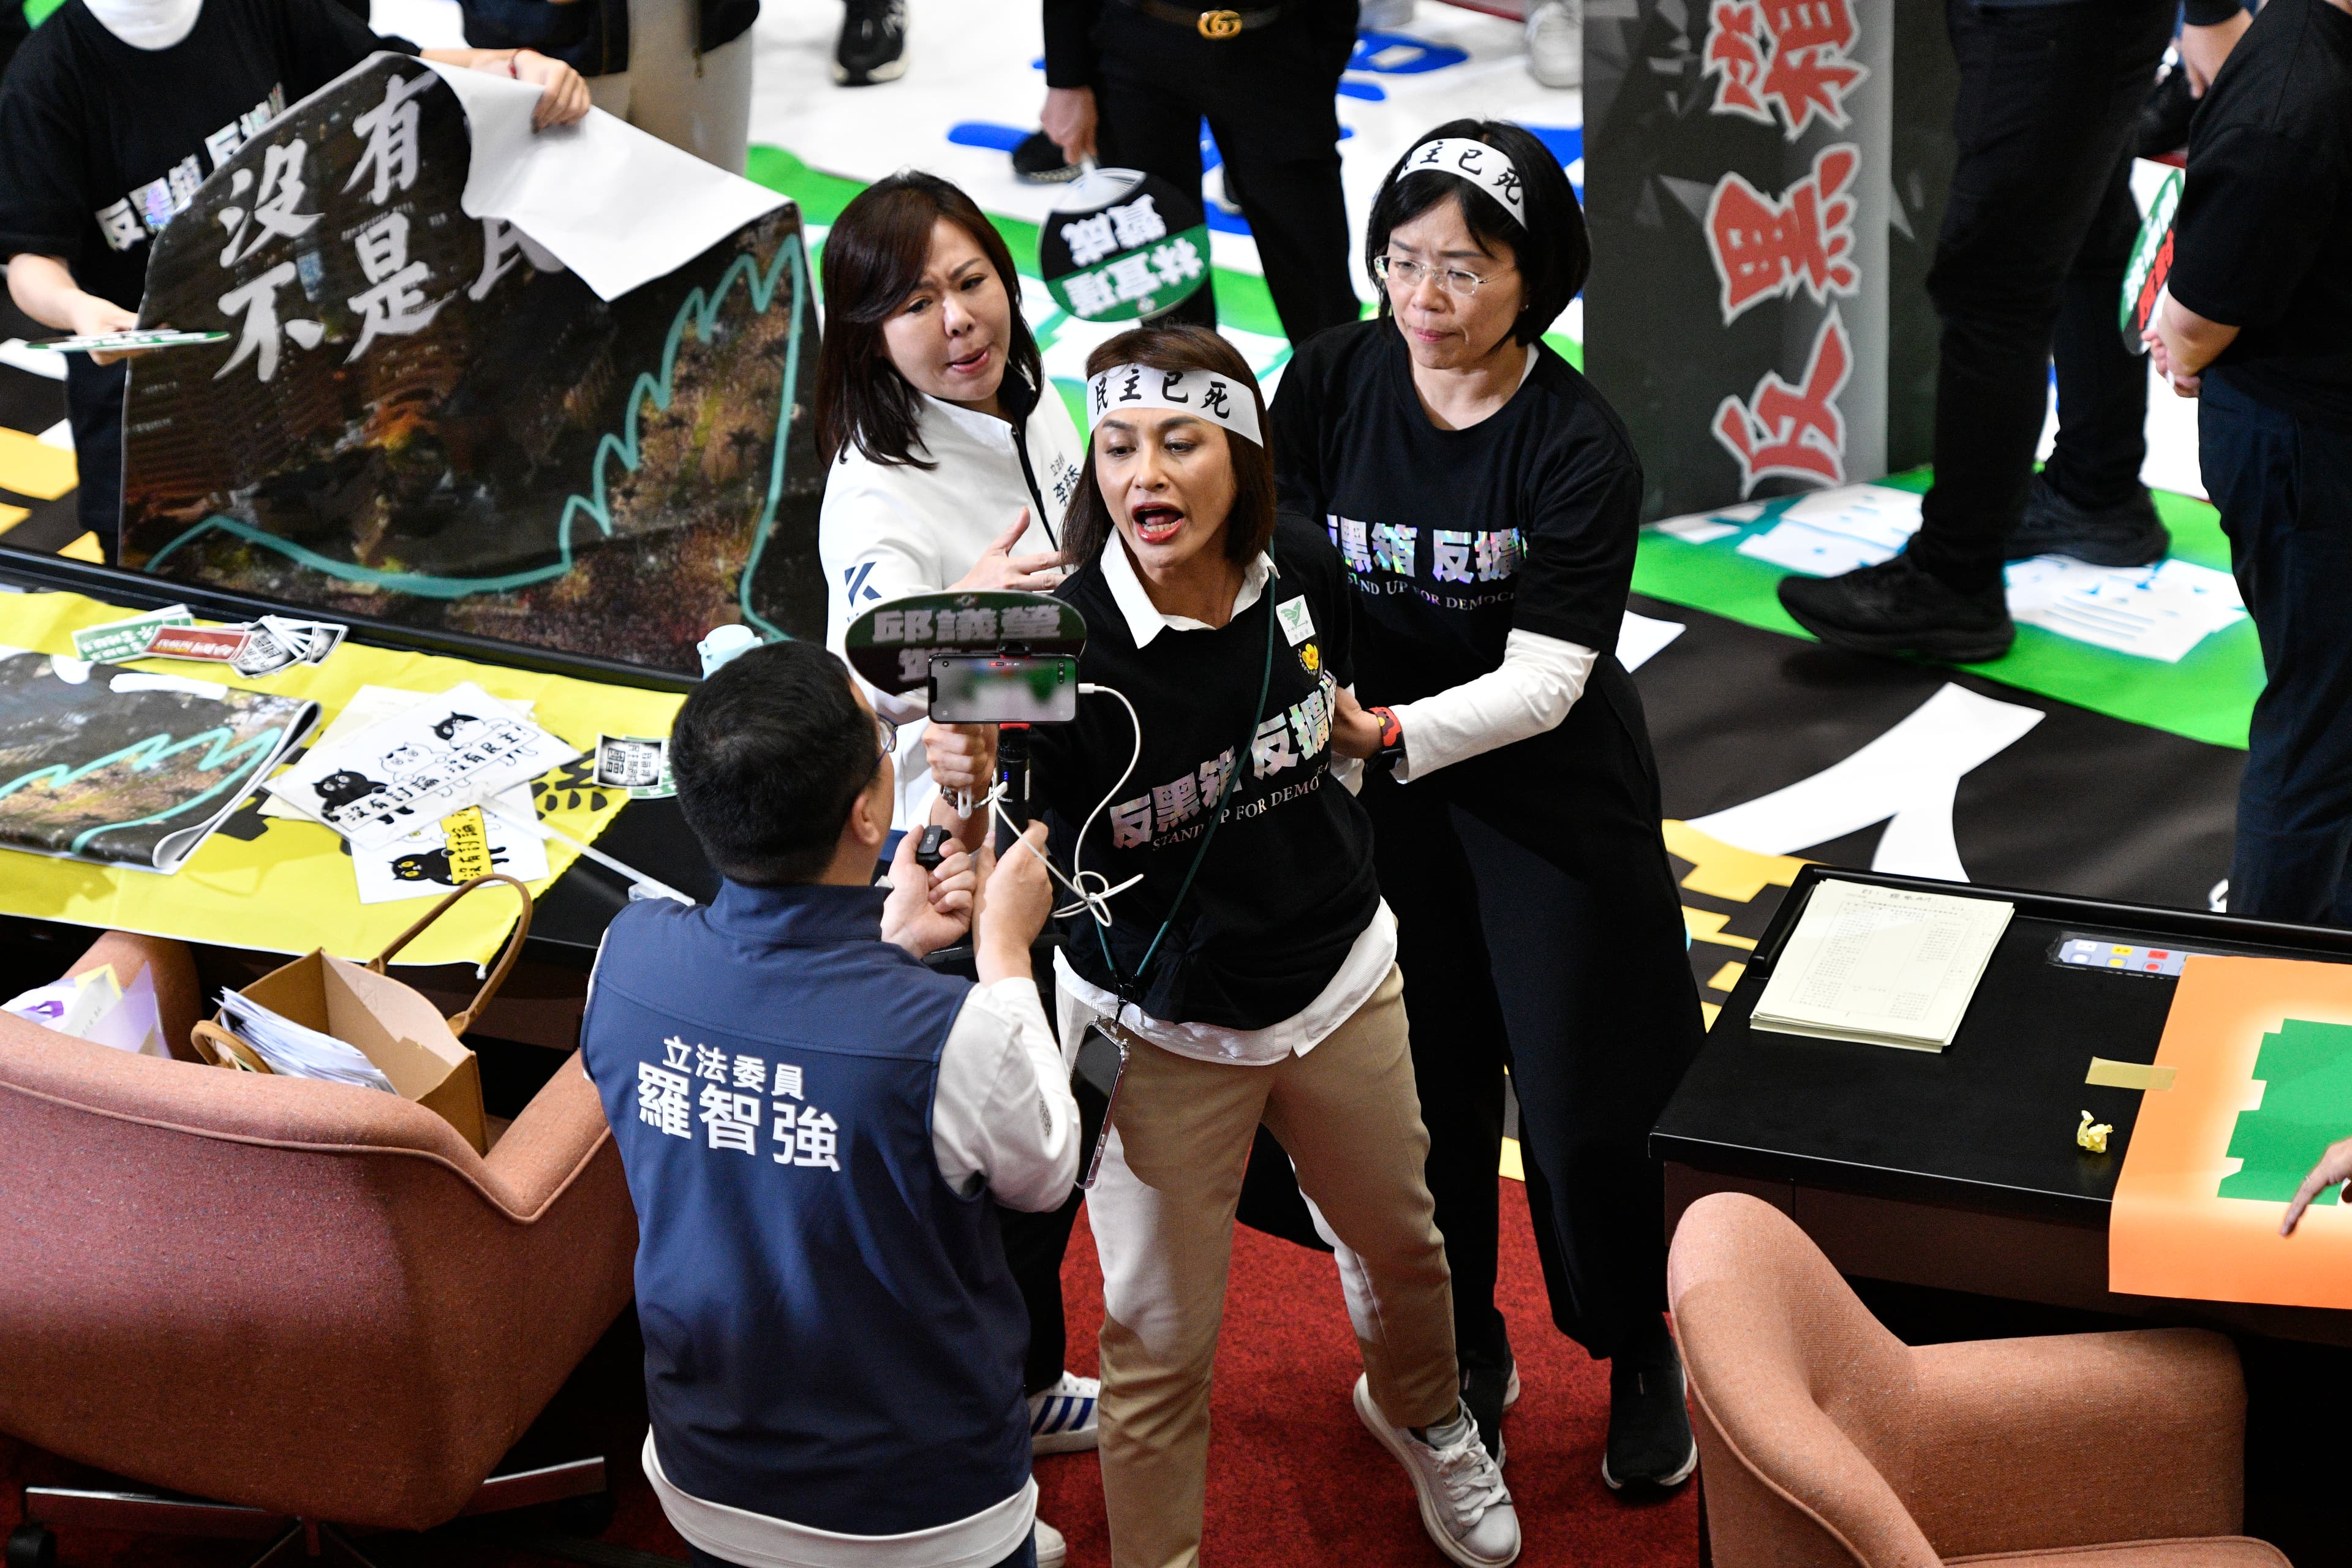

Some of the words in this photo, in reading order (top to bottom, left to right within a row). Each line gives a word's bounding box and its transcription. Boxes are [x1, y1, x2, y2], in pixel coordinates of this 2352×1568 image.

[219, 70, 440, 268] 沒有
[1703, 0, 1871, 500] 反黑箱
[1095, 369, 1230, 419] 民主已死
[1348, 571, 1380, 595] STND
[1385, 580, 1408, 596] UP
[1433, 525, 1529, 584] 反擴
[1109, 745, 1243, 849] 反黑箱
[1152, 823, 1205, 851] STAND
[1235, 798, 1268, 821] FOR
[662, 1035, 805, 1101] 立法委員
[638, 1061, 841, 1172] 羅智強
